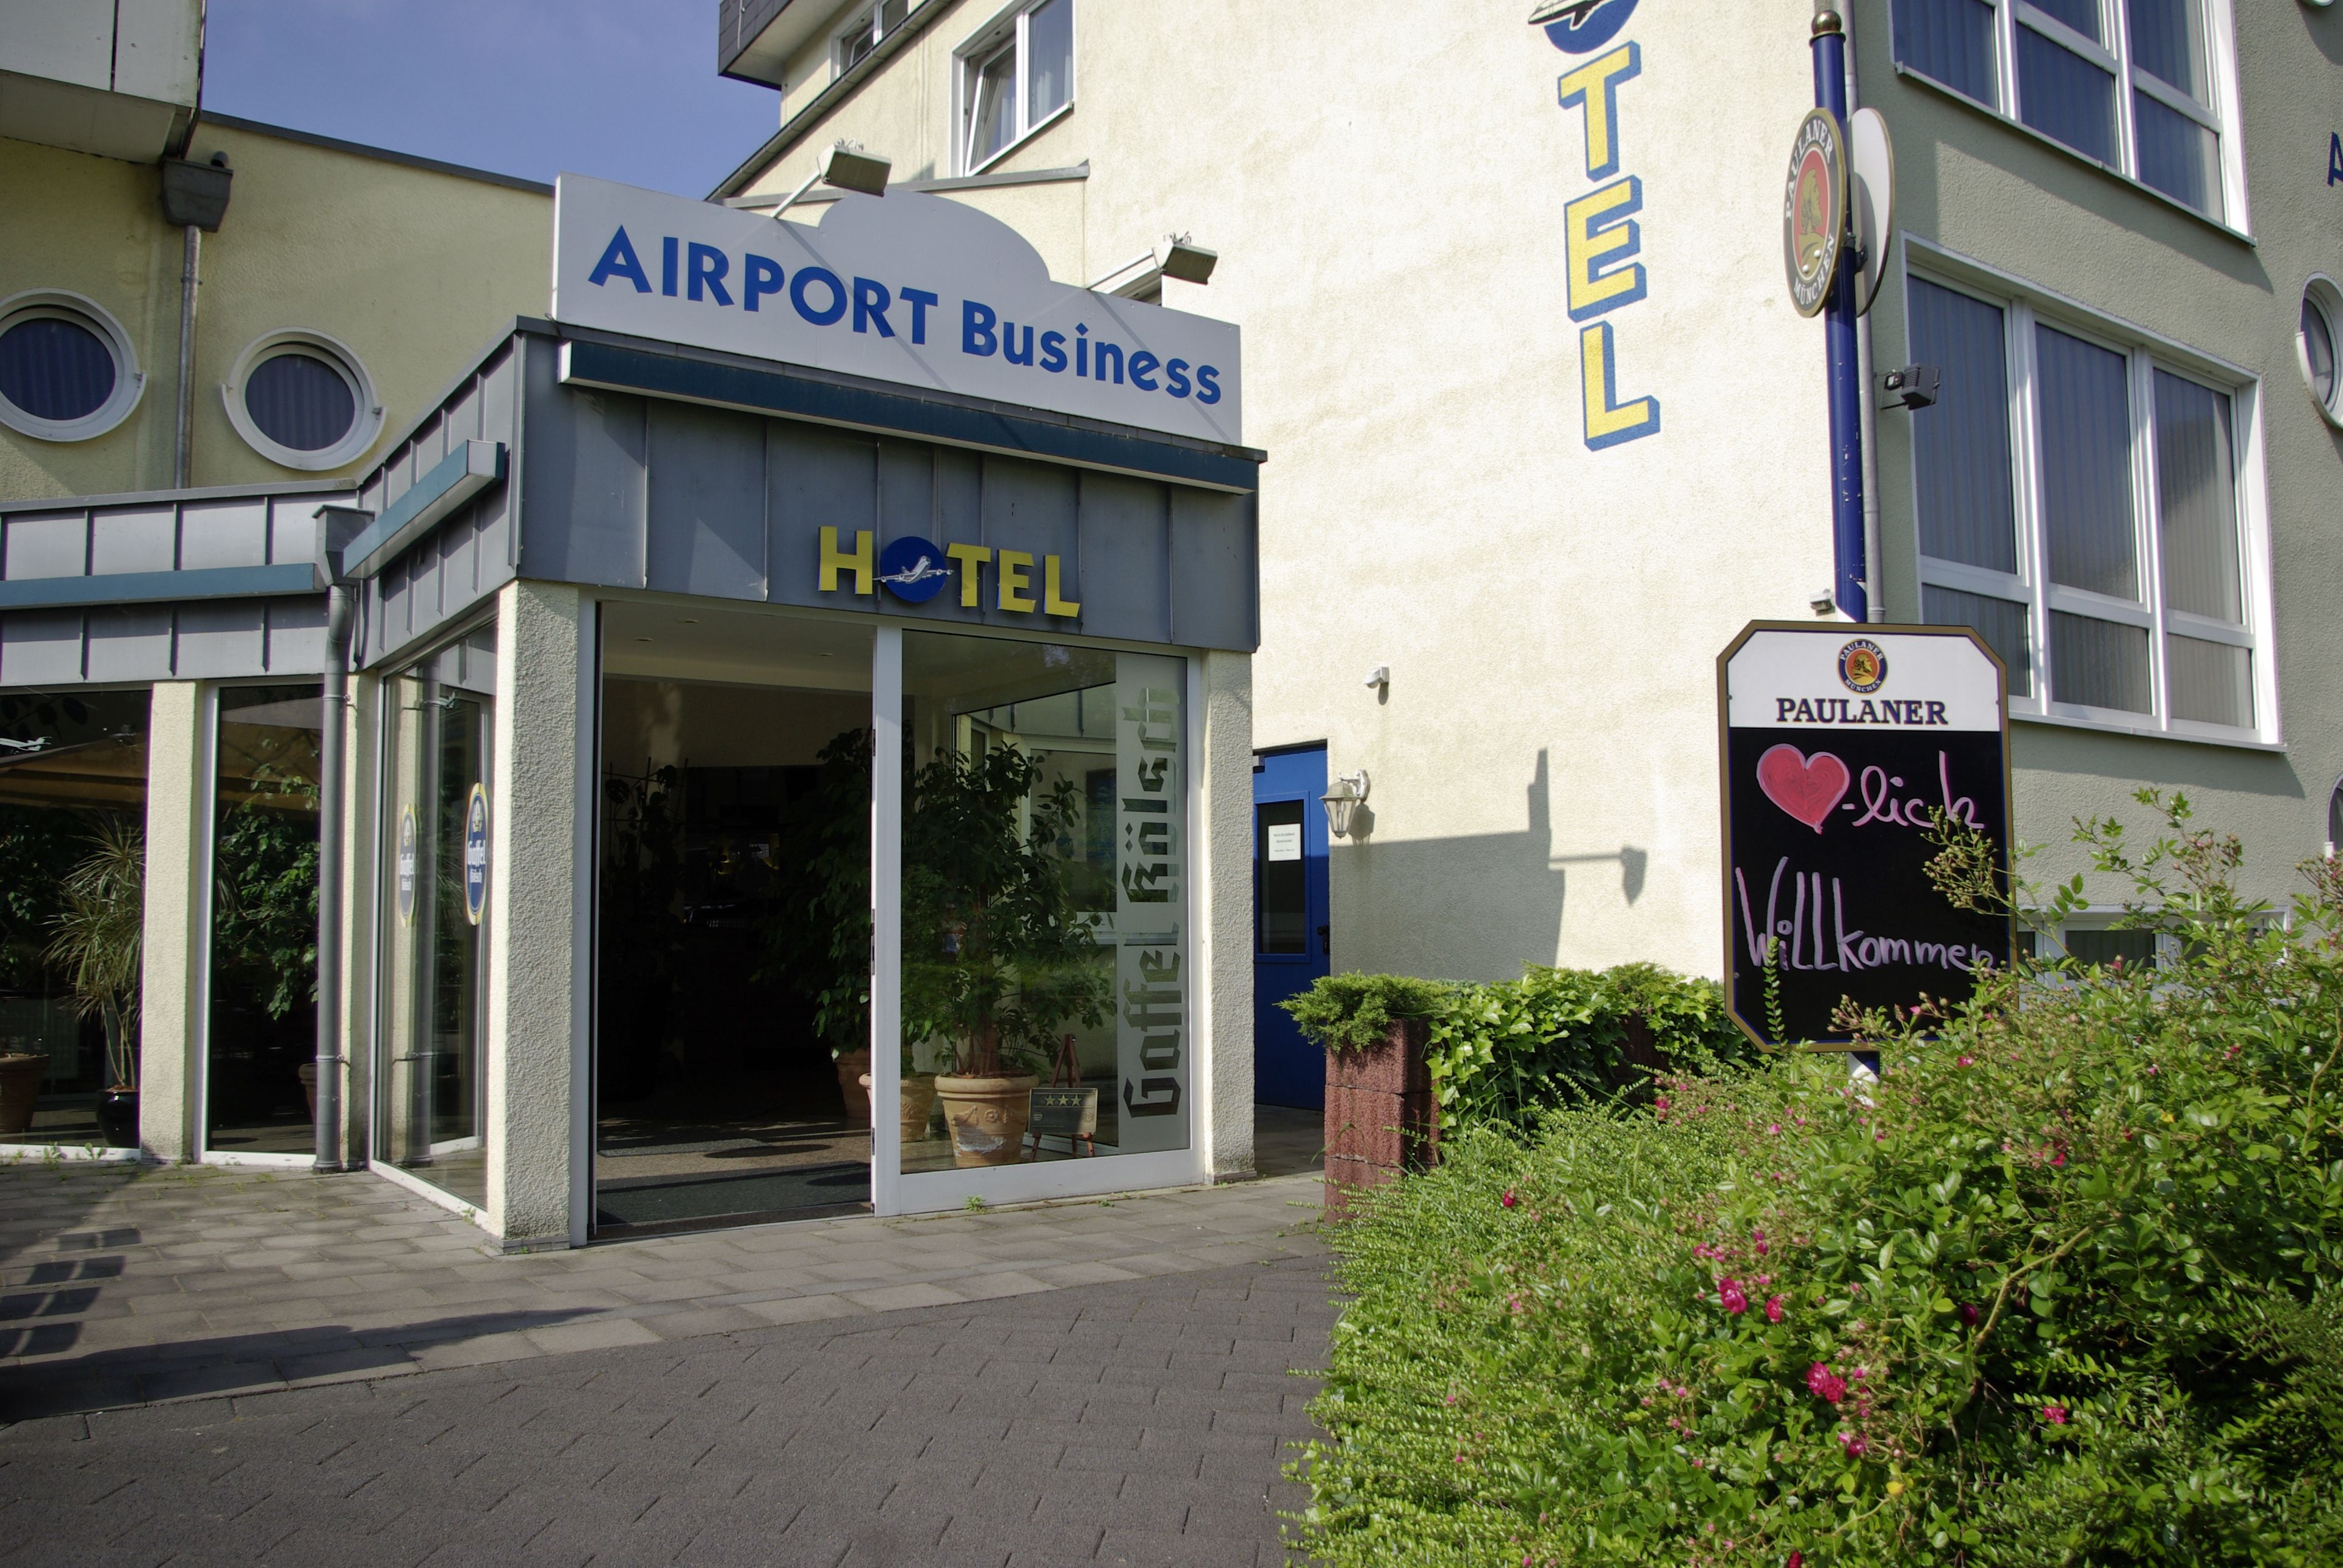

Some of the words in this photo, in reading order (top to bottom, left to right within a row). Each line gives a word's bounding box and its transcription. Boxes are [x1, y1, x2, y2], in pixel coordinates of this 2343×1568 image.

[1785, 119, 1833, 220] PAULANER
[588, 225, 938, 345] AIRPORT
[962, 300, 1222, 405] Business
[1793, 233, 1835, 305] MÜNCHEN
[817, 525, 1081, 617] HOTEL
[1840, 641, 1883, 660] PAULANER
[1776, 698, 1948, 725] PAULANER
[1735, 856, 2000, 974] Willkommen
[1123, 921, 1182, 1119] Gaffel
